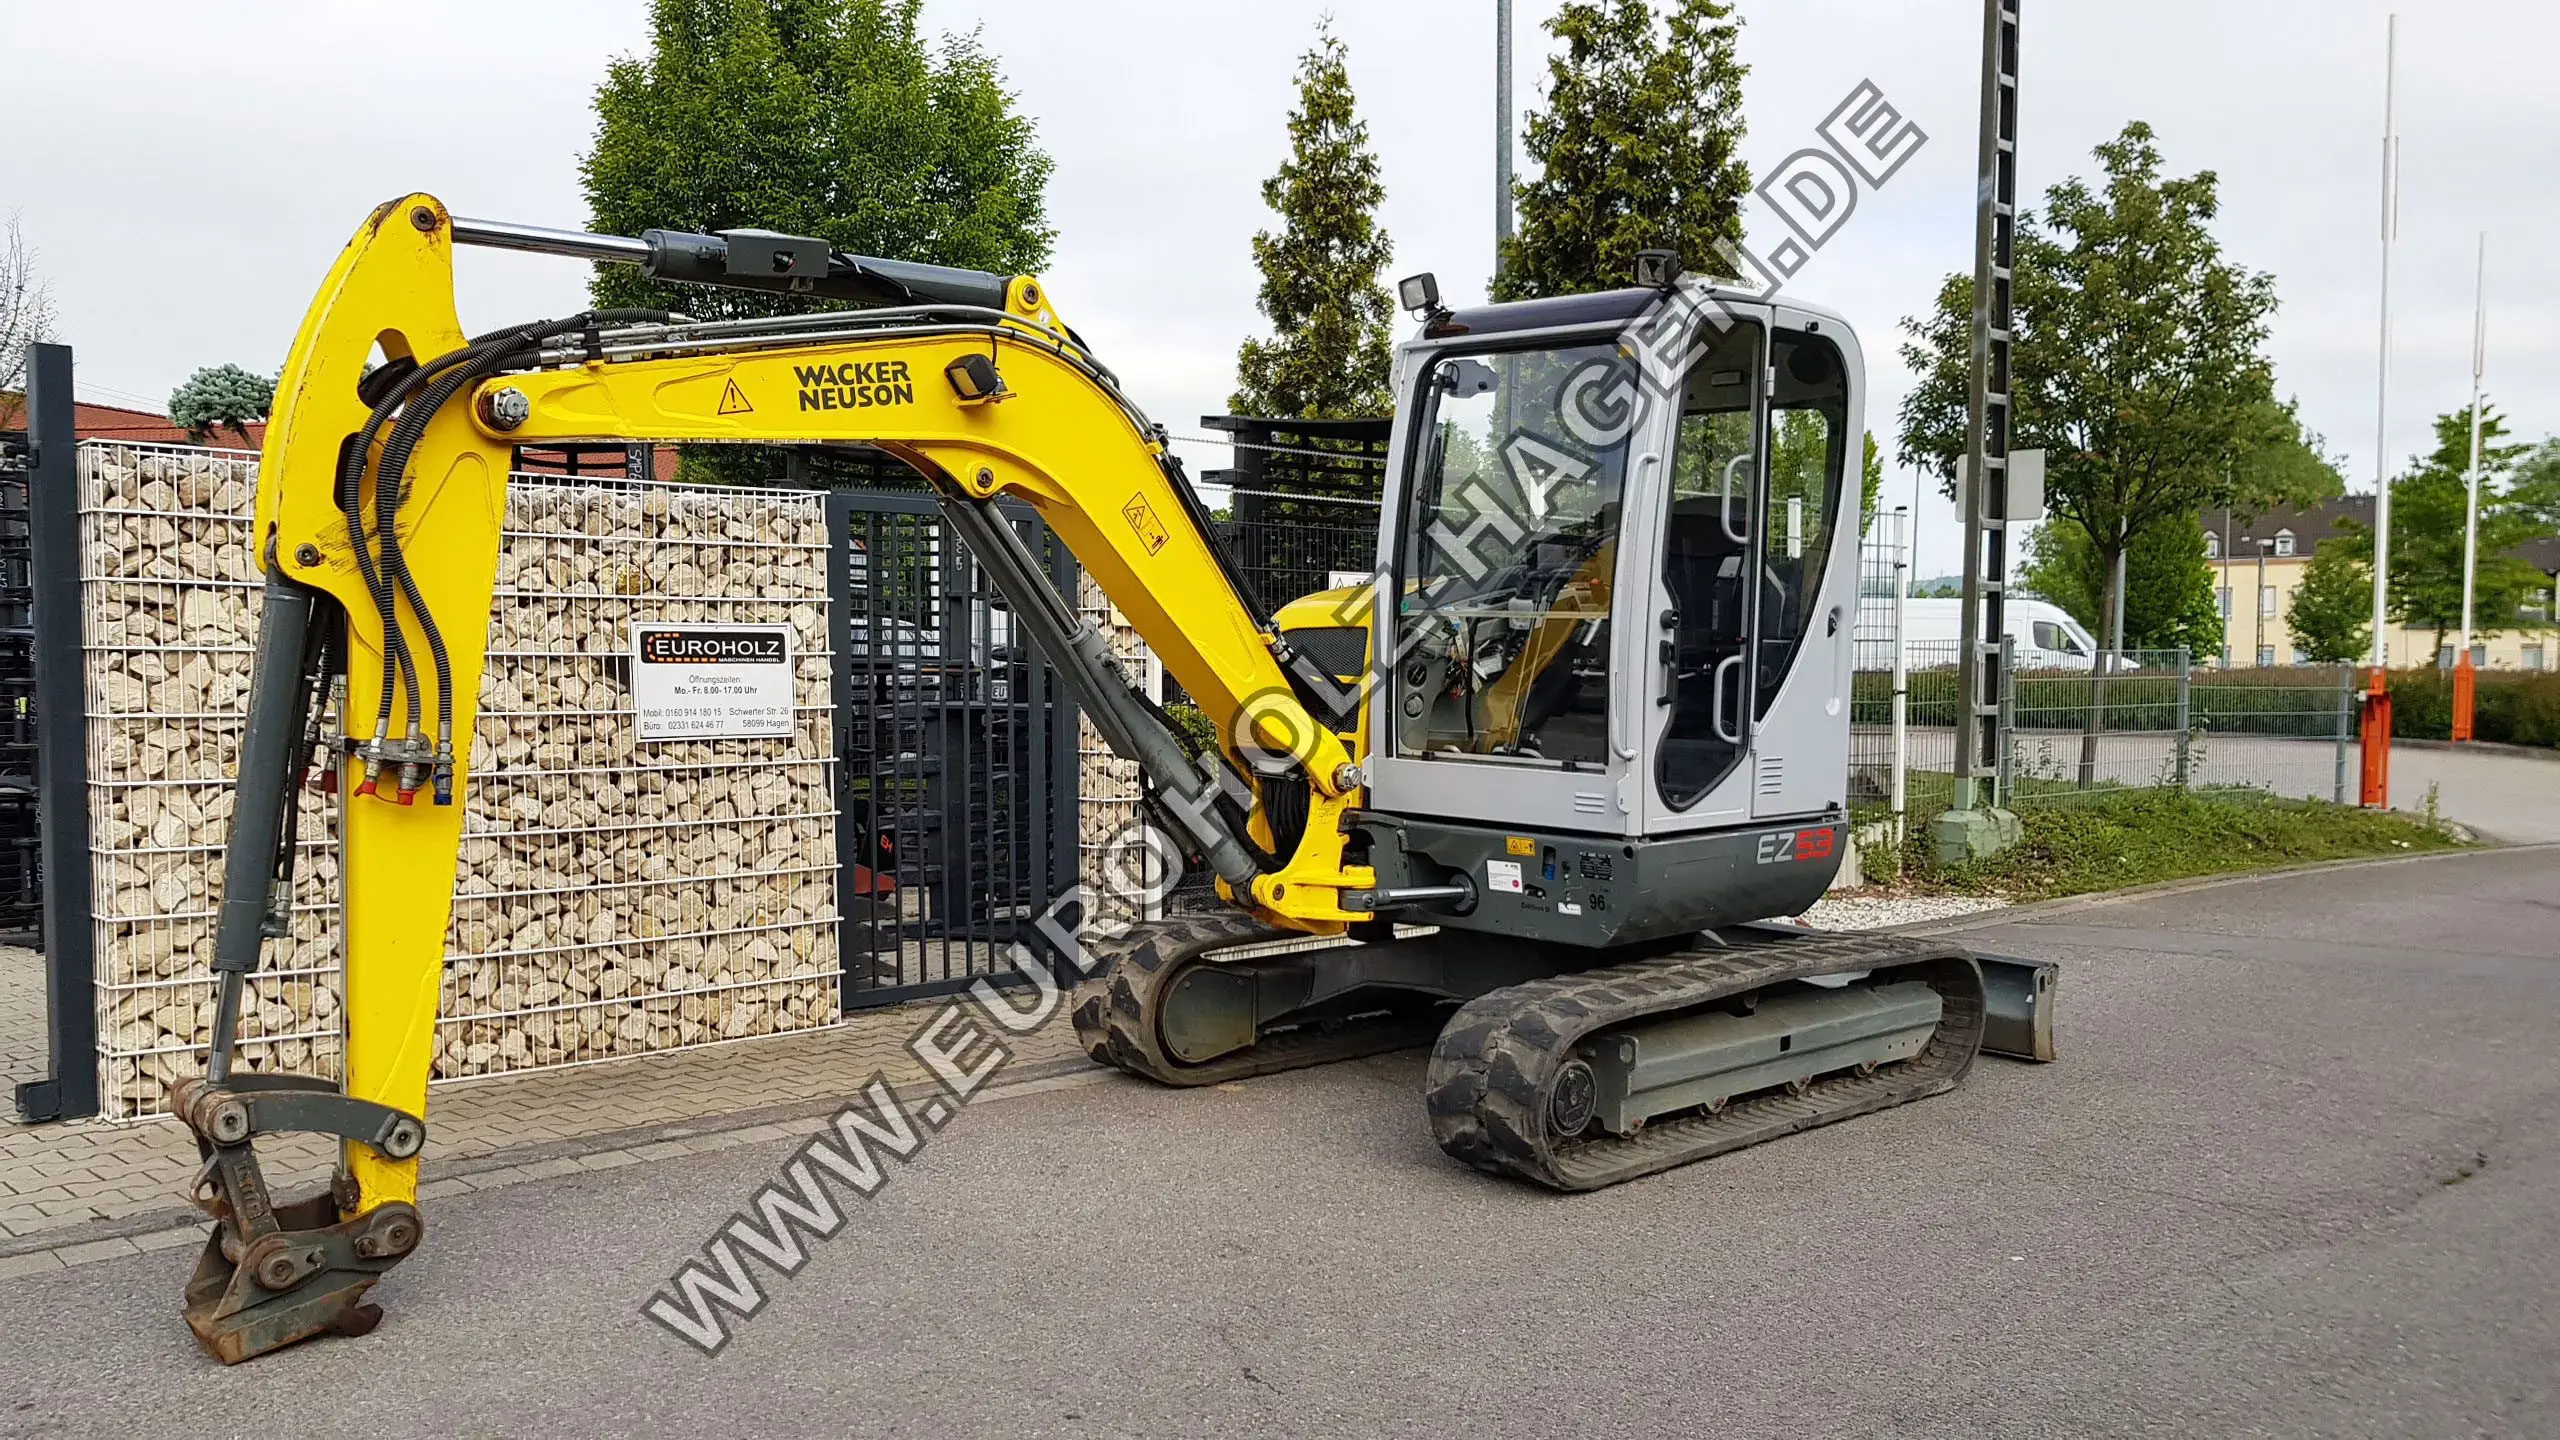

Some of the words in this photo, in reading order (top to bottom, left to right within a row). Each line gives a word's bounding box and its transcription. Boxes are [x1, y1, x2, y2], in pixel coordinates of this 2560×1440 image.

[793, 360, 912, 387] WACKER
[798, 383, 914, 411] NEUSON
[655, 640, 780, 656] EUROHOLZ
[744, 686, 758, 694] Uhr
[643, 708, 664, 717] Mobil:
[665, 708, 683, 717] 0160
[684, 708, 697, 716] 914
[699, 708, 712, 716] 180
[714, 707, 722, 716] 15
[728, 707, 764, 716] Schwerter
[766, 707, 778, 715] Str.
[780, 707, 789, 715] 26
[643, 721, 662, 730] Büro:
[668, 721, 689, 729] 02331
[691, 721, 704, 729] 624
[715, 720, 724, 728] 77
[742, 719, 765, 727] 58099
[766, 719, 790, 728] Hagen
[1756, 827, 1835, 865] EZ53
[1589, 893, 1606, 911] 96
